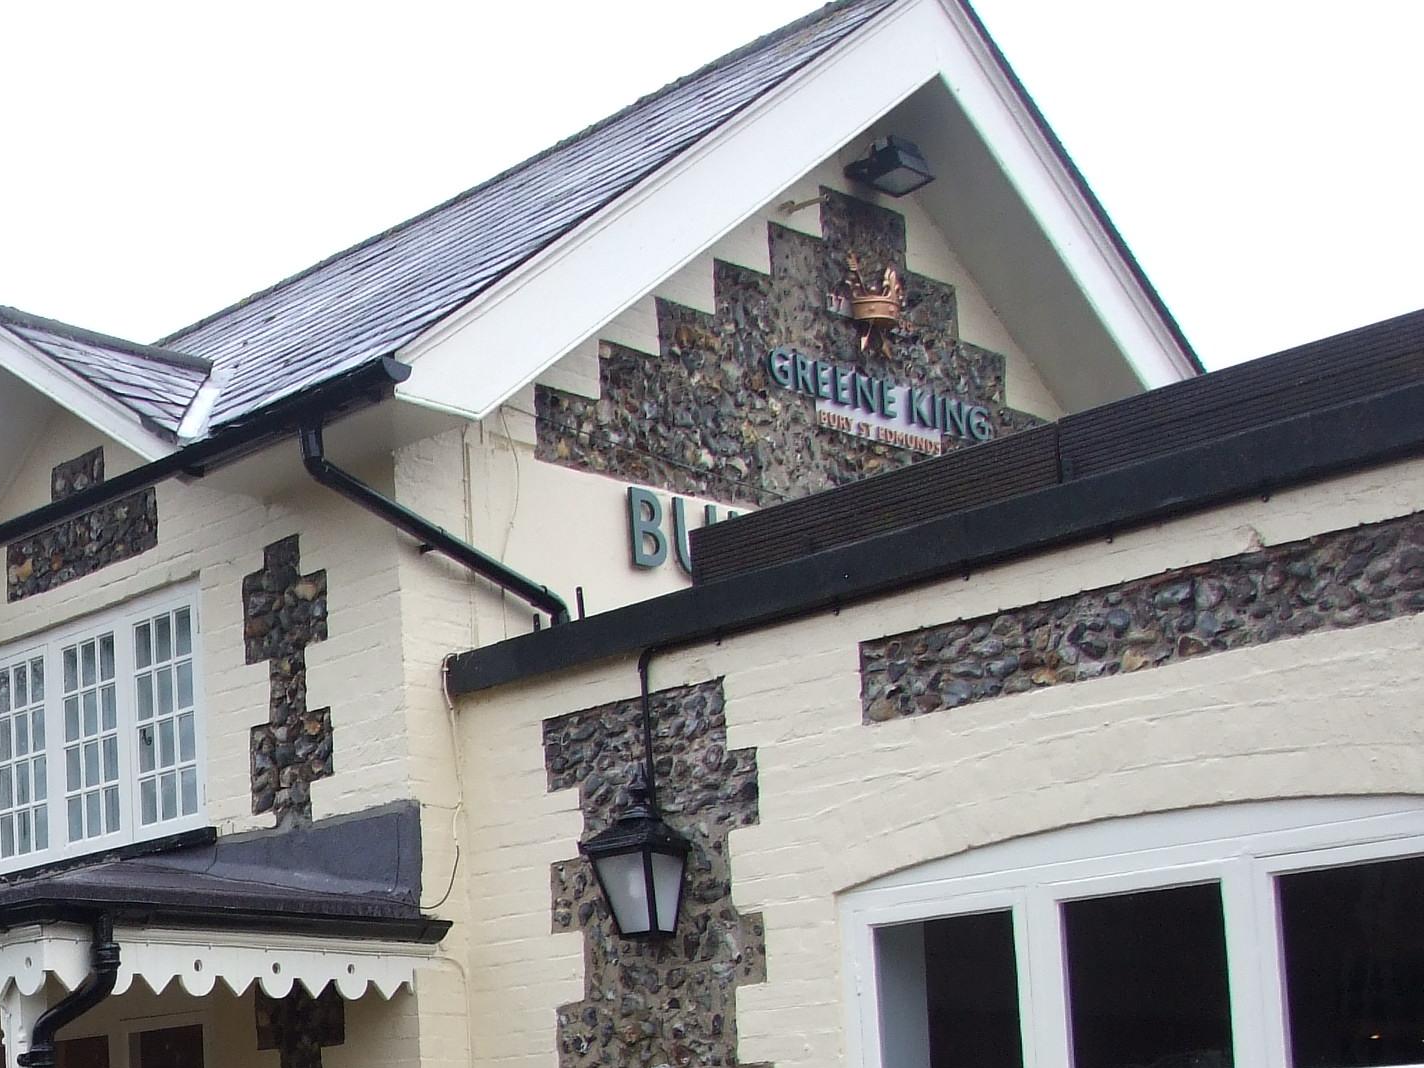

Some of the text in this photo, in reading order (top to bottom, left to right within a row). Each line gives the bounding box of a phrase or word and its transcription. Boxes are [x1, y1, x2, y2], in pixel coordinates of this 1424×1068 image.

[769, 348, 992, 440] GREENE KING
[819, 408, 942, 456] BURY ST EDMUNDS
[627, 486, 738, 576] BU
